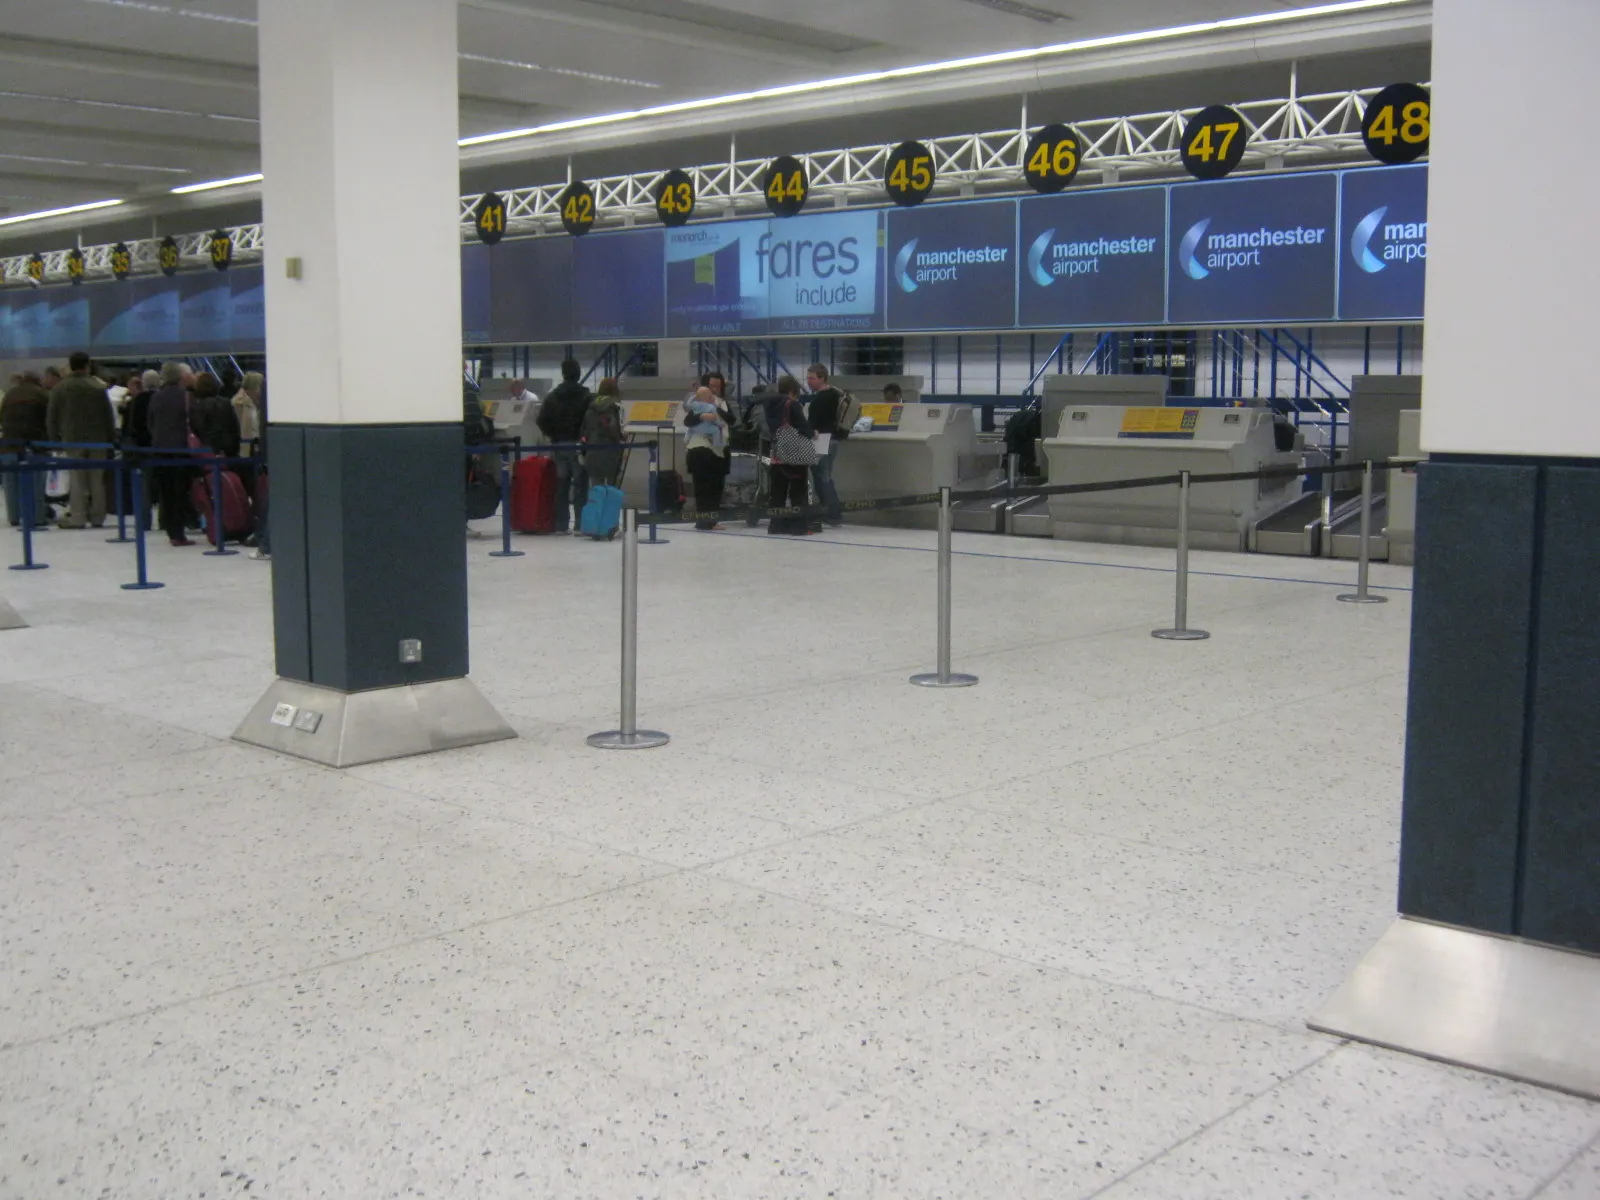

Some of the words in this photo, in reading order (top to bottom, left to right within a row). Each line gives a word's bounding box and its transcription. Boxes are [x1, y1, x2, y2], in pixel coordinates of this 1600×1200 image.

[1368, 101, 1430, 145] 48
[1188, 122, 1239, 162] 47
[1028, 139, 1076, 177] 46
[889, 156, 931, 192] 45
[659, 183, 692, 214] 43
[767, 170, 805, 203] 44
[480, 204, 502, 232] 41
[564, 194, 593, 223] 42
[1053, 236, 1156, 258] manchester
[1207, 225, 1326, 249] manchester
[112, 251, 129, 273] 35
[160, 245, 177, 268] 36
[212, 238, 231, 262] 37
[756, 231, 860, 284] fares
[916, 246, 1008, 266] manchester
[1207, 249, 1261, 270] airport
[68, 257, 84, 278] 34
[916, 266, 958, 284] airport
[1052, 257, 1099, 277] airport
[795, 281, 857, 306] include
